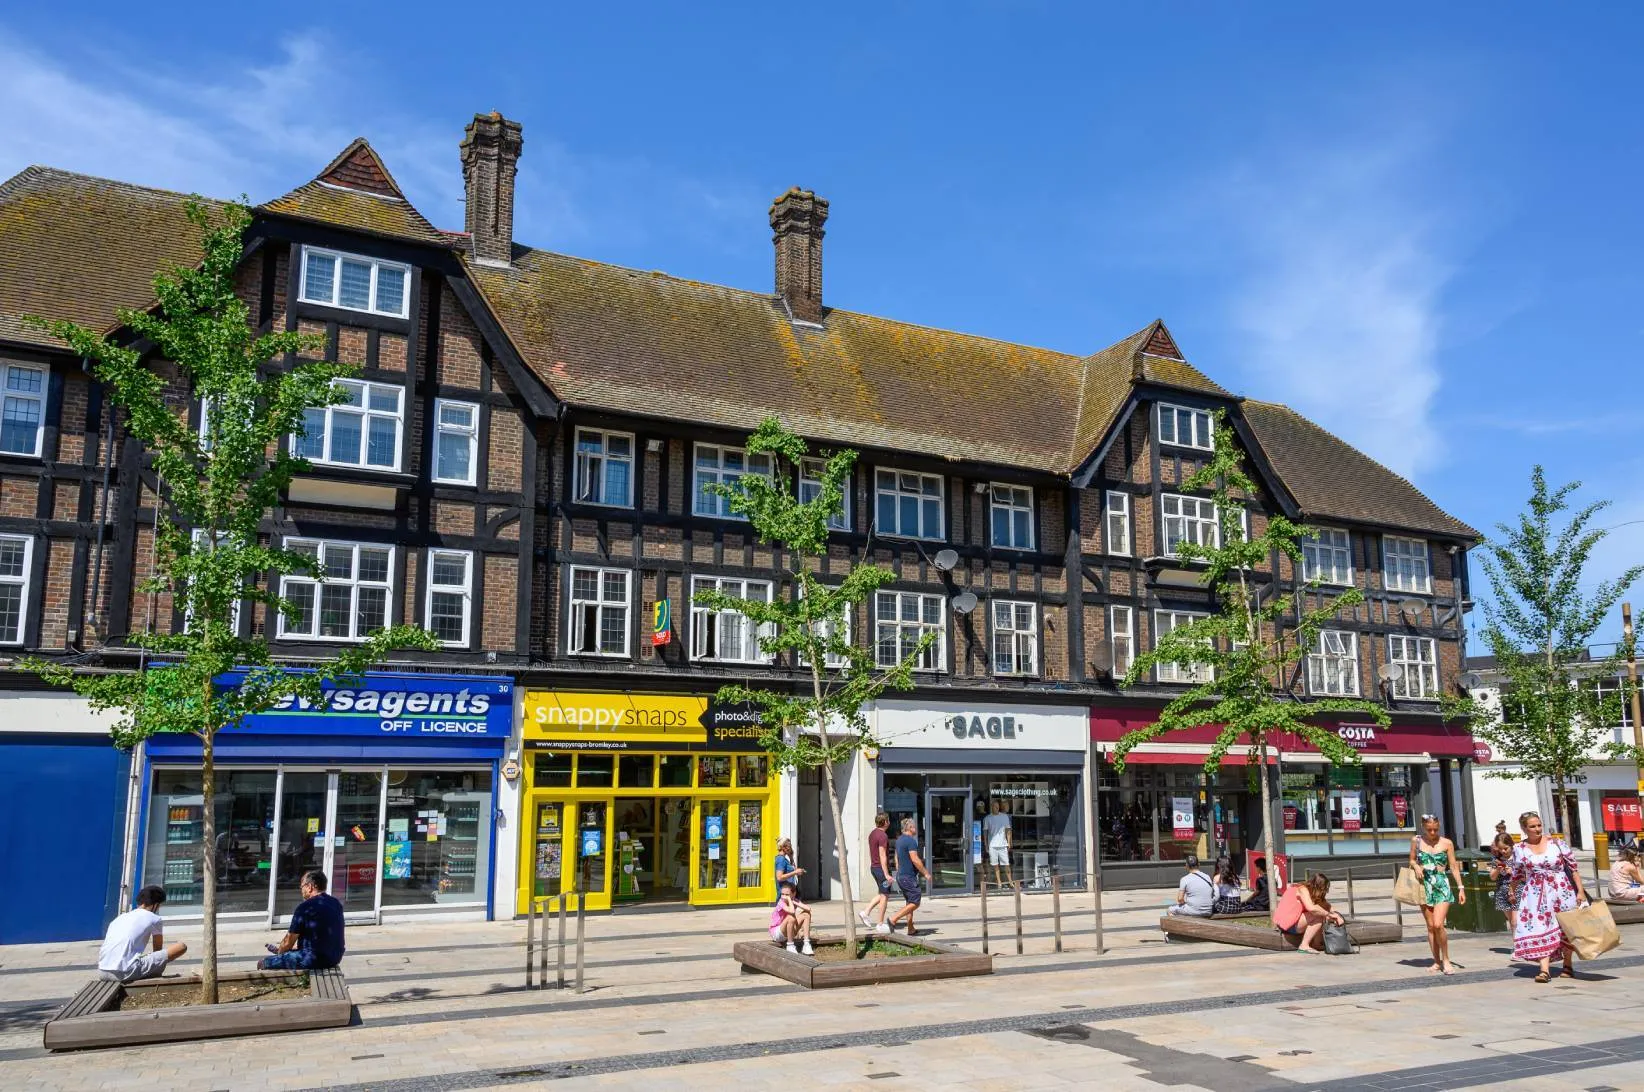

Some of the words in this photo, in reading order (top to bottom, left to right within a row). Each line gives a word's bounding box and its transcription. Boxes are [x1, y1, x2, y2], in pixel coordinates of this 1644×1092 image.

[498, 685, 509, 693] 30
[380, 720, 413, 732] OFF
[421, 721, 488, 733] LICENCE
[1338, 726, 1375, 740] COSTA
[990, 788, 1058, 797] www.sageclothing.co.uk
[1607, 803, 1638, 812] SALE
